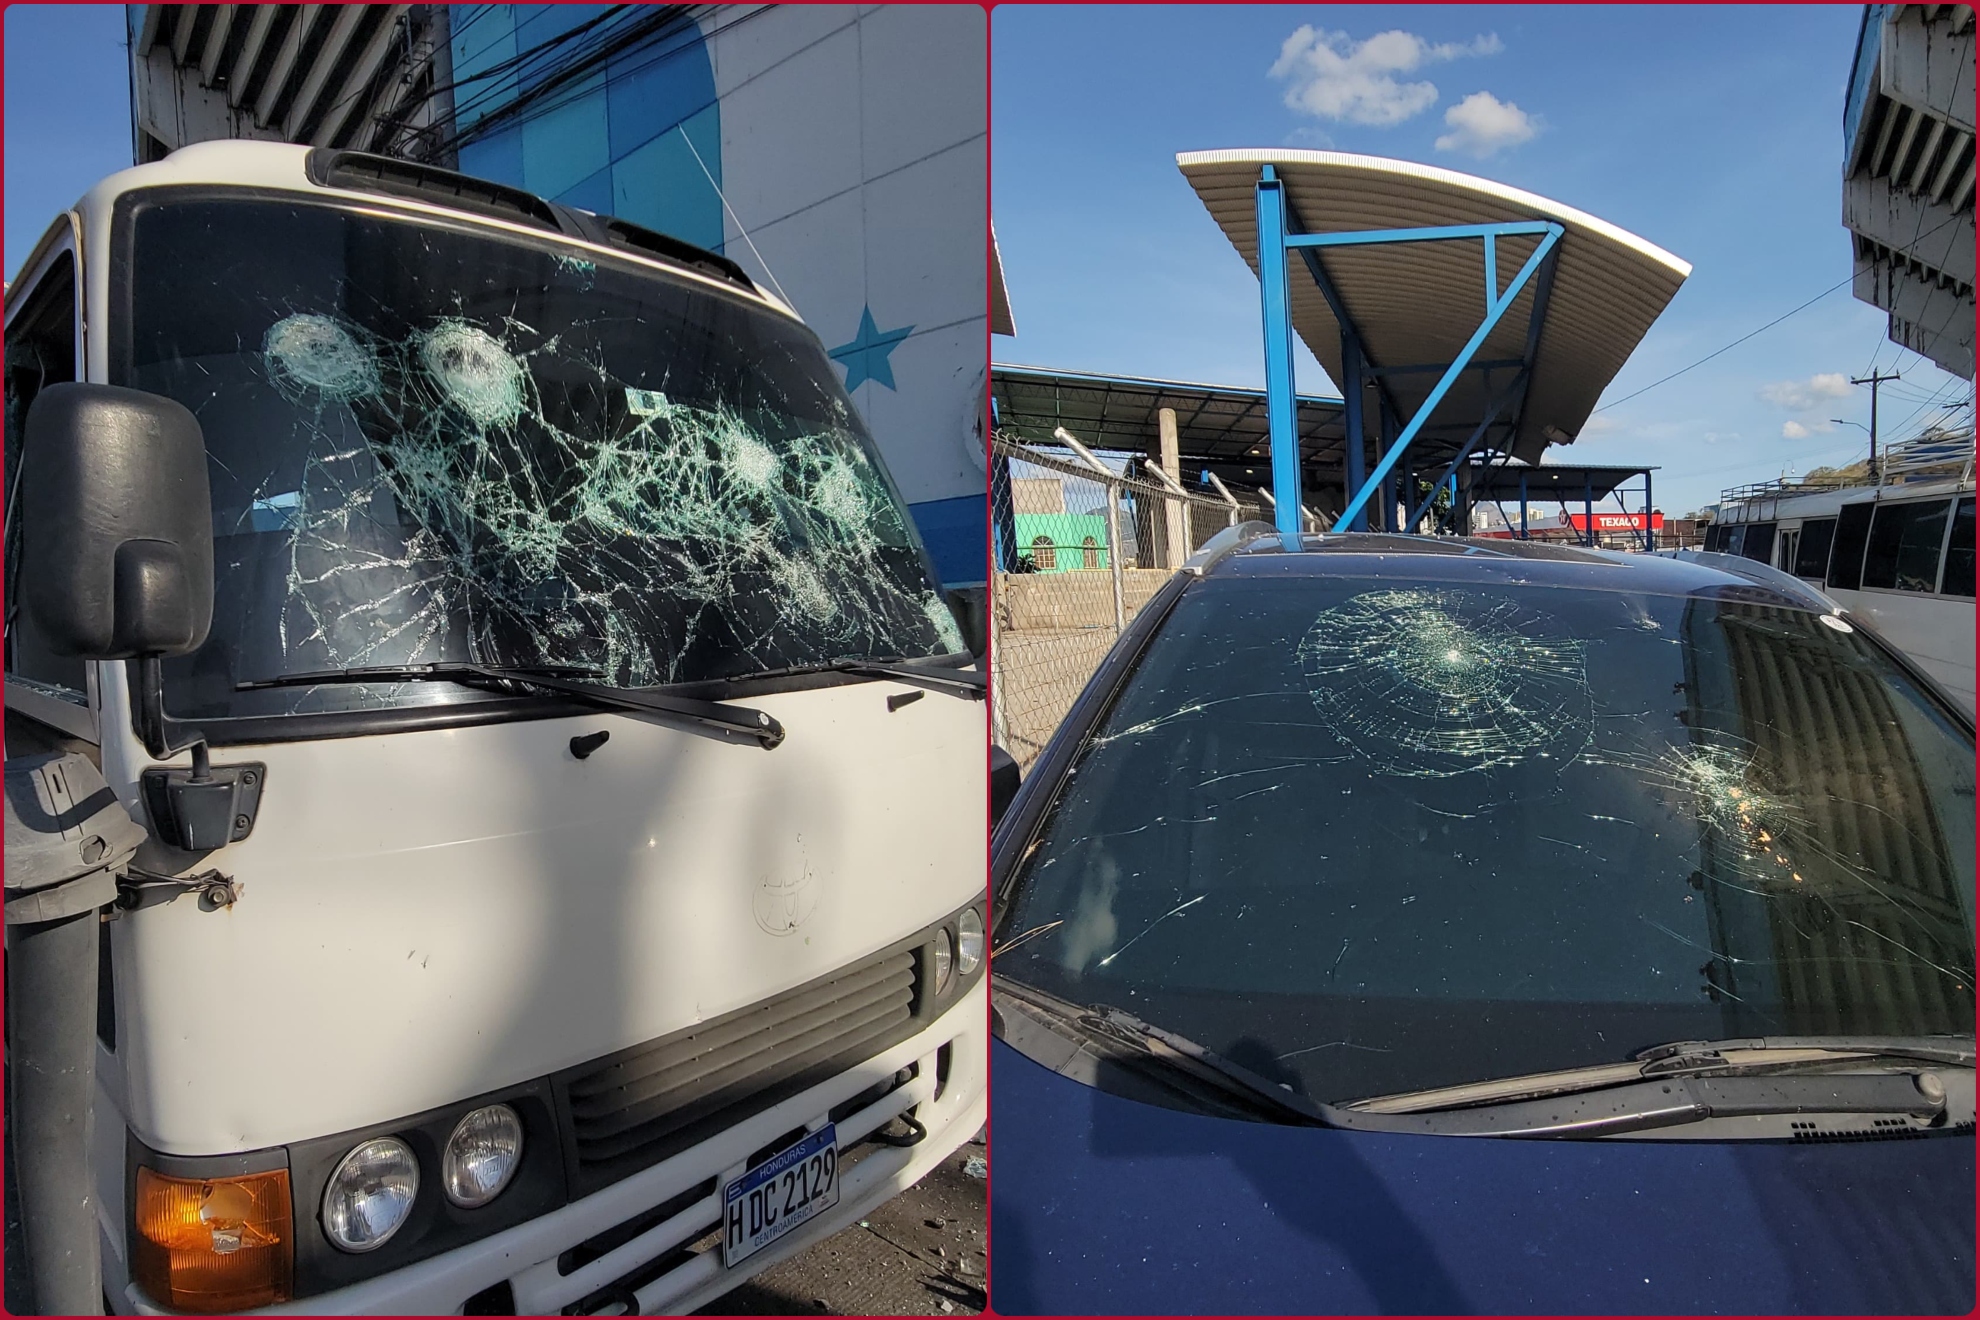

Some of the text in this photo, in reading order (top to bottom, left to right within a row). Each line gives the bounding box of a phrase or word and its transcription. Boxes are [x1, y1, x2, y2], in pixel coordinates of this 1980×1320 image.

[1599, 517, 1639, 527] TEXACO
[759, 1144, 806, 1179] HONDURAS
[782, 1147, 835, 1218] 2129
[754, 1204, 813, 1247] CENTROAMERICA
